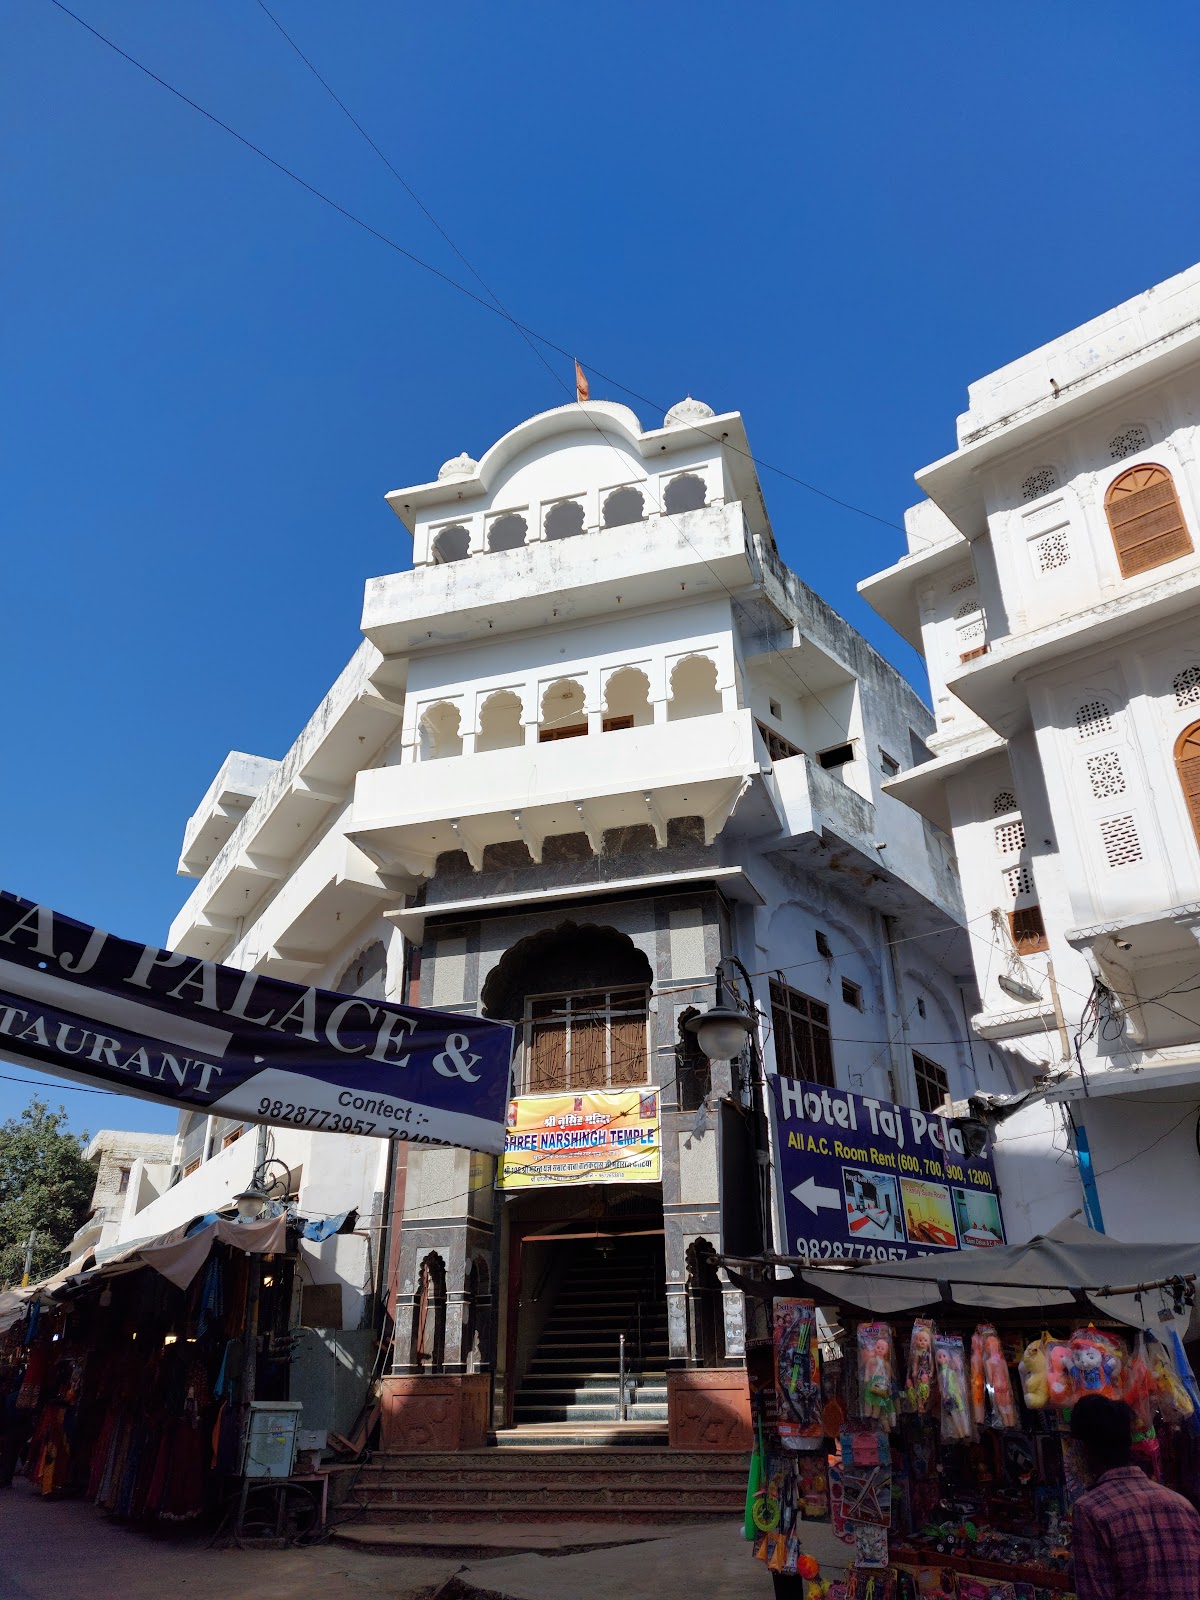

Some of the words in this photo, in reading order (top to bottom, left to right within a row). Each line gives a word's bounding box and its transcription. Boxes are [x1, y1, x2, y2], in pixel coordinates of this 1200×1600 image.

[0, 897, 108, 973] AJ
[123, 945, 418, 1067] PALACE
[432, 1033, 482, 1082] &
[338, 1091, 412, 1122] Contect
[543, 1115, 556, 1127] श्री
[780, 1077, 857, 1131] Hotel
[863, 1097, 904, 1149] Taj
[540, 1129, 606, 1150] NARSHINGH
[610, 1128, 655, 1146] TEMPLE
[788, 1132, 804, 1149] All
[807, 1136, 832, 1156] A.C.
[835, 1142, 868, 1162] Room
[871, 1149, 896, 1168] Rent
[897, 1156, 923, 1176] (600,
[924, 1159, 945, 1180] 700,
[967, 1168, 992, 1190] 1200)
